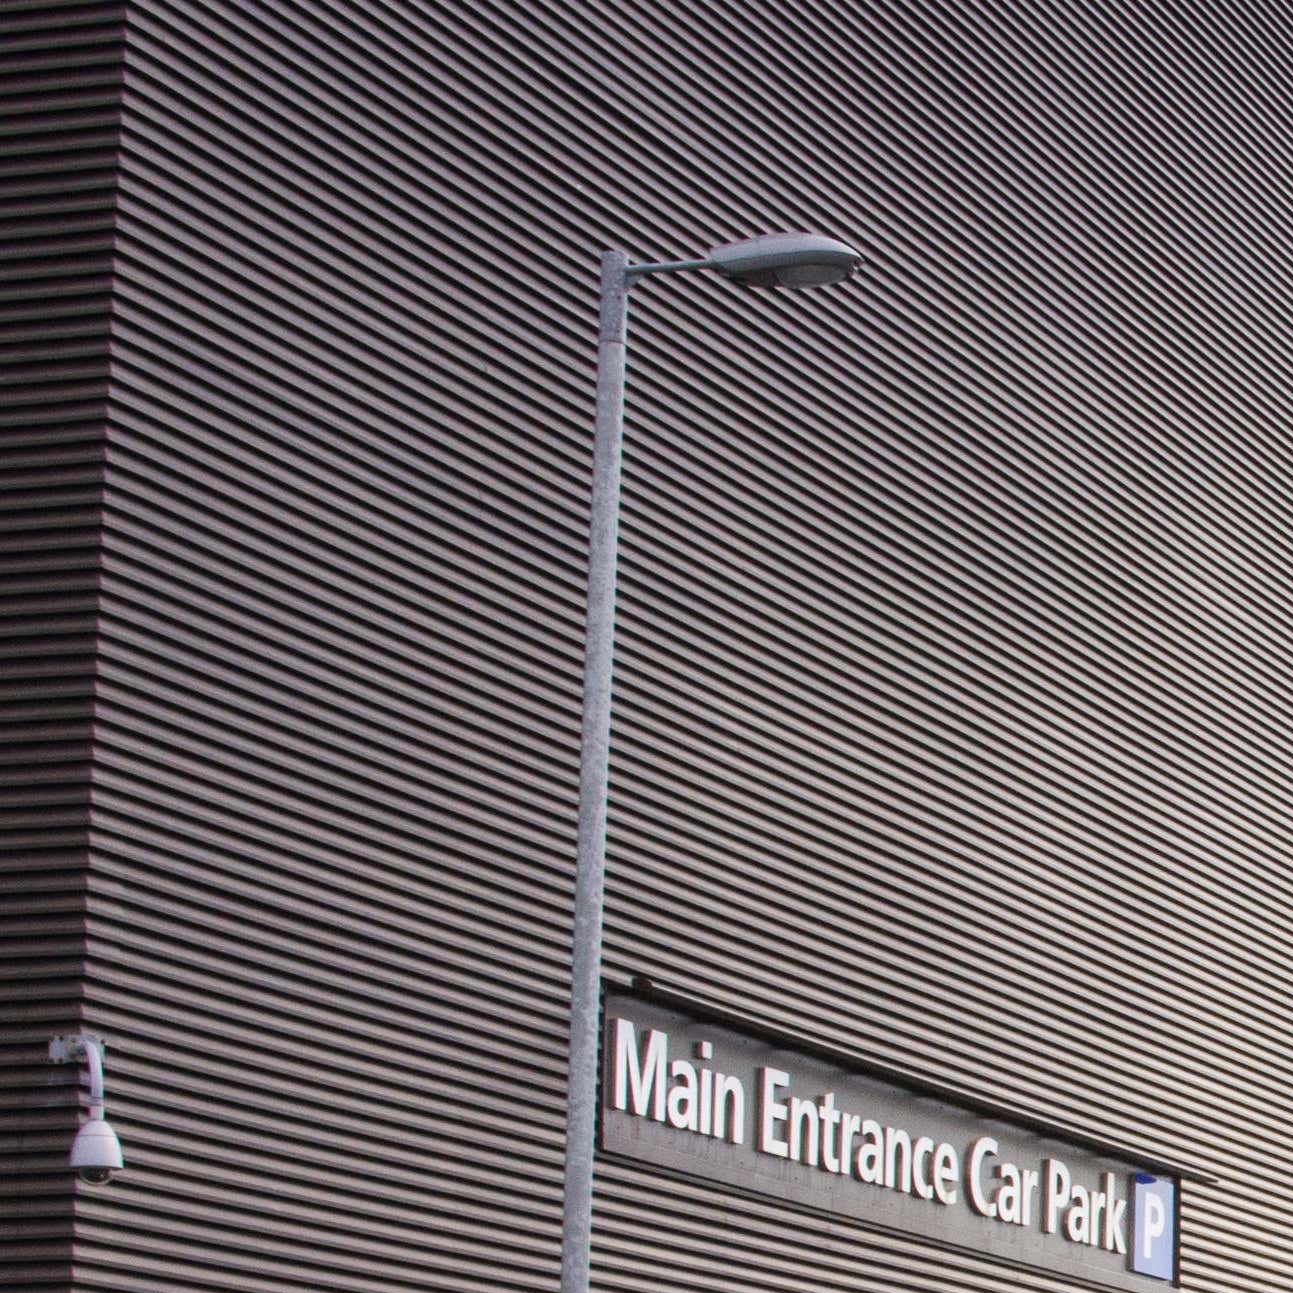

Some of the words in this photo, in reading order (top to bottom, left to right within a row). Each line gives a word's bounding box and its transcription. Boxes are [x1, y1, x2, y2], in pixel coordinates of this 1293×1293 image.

[613, 1017, 745, 1145] Main
[760, 1066, 960, 1206] Entrance
[968, 1136, 1039, 1226] Car
[1044, 1158, 1128, 1255] Park
[1143, 1191, 1166, 1259] P
